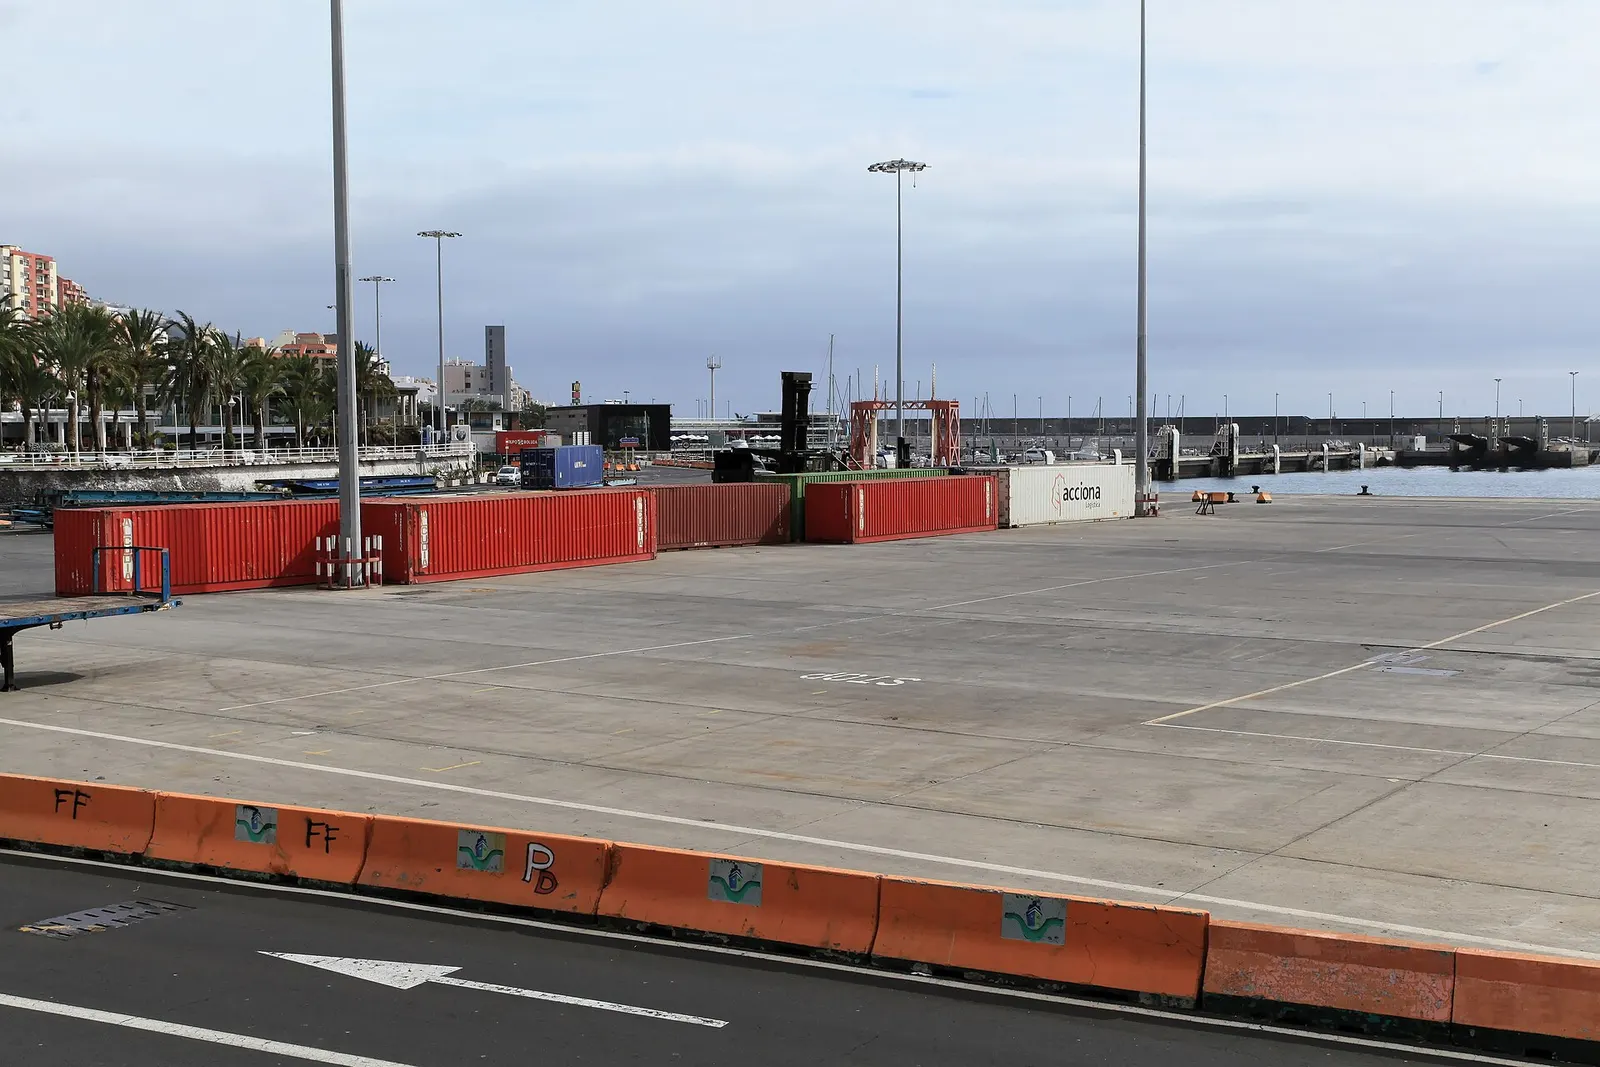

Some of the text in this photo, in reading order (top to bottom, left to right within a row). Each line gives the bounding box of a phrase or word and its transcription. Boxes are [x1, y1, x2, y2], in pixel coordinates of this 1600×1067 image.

[1062, 481, 1101, 501] acciona
[54, 788, 91, 820] FF
[304, 817, 340, 854] FF
